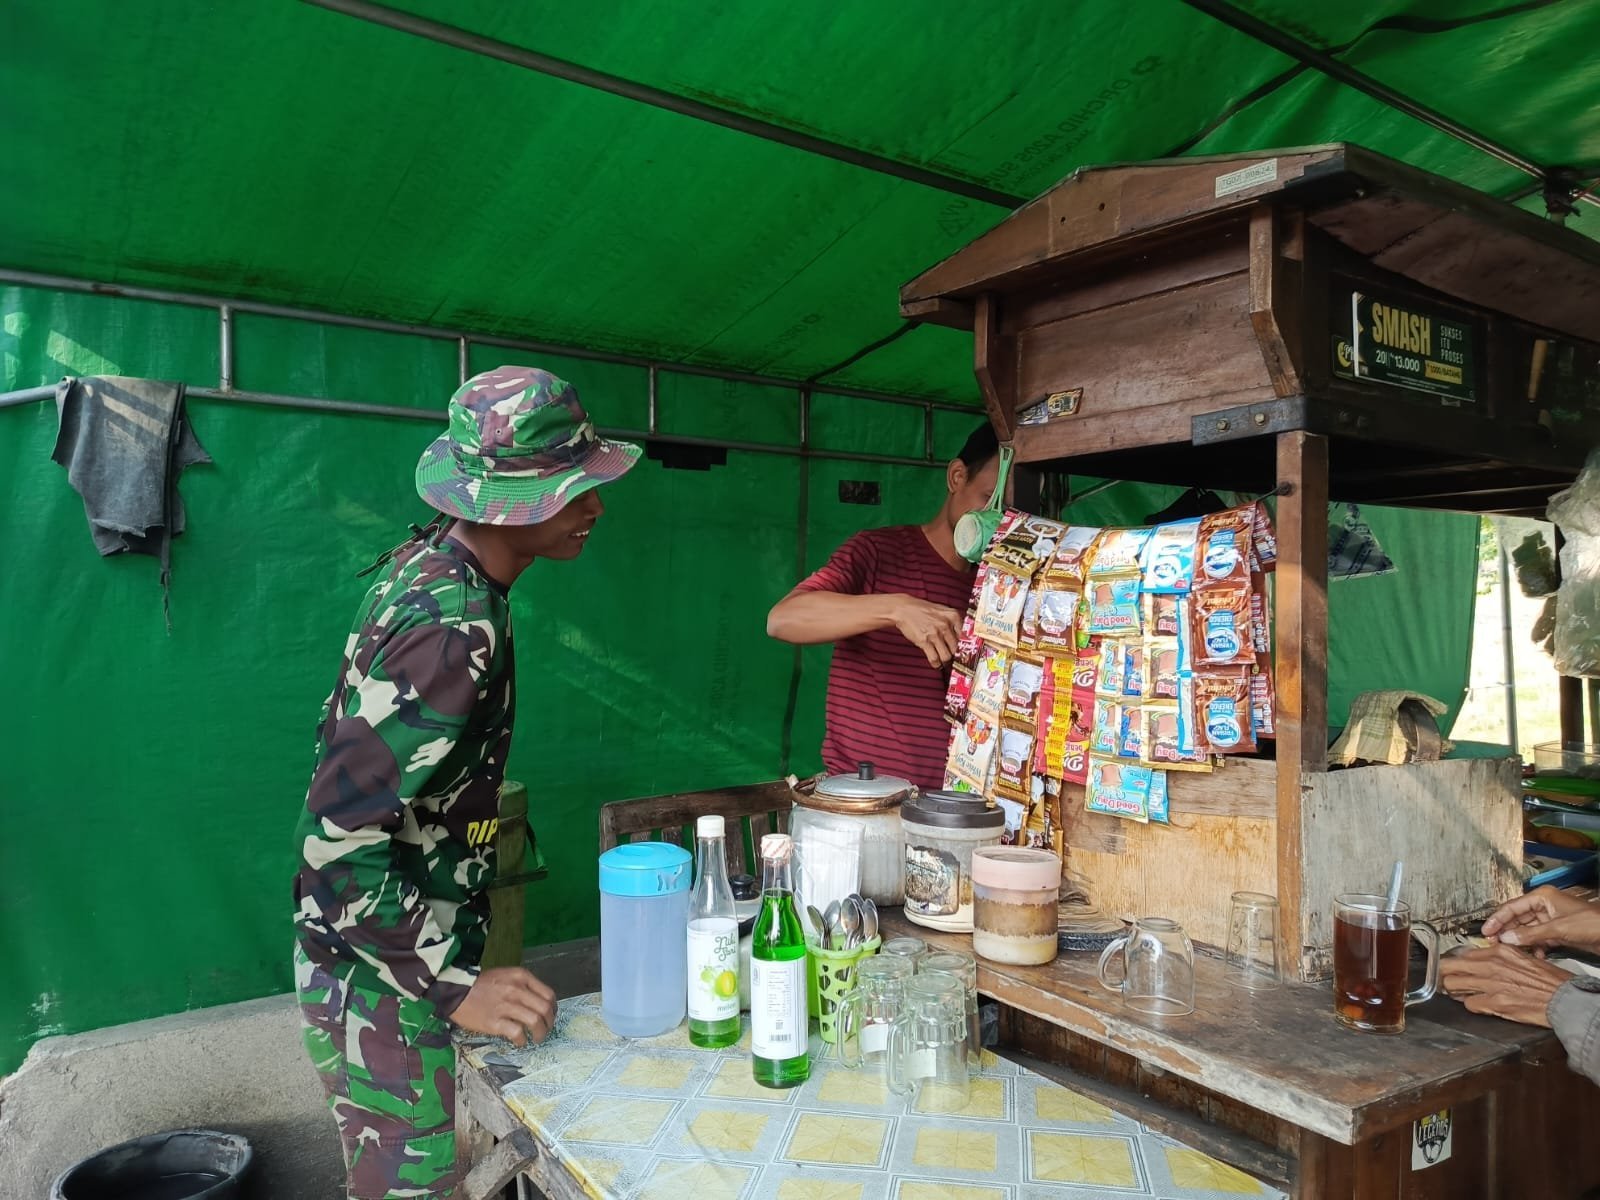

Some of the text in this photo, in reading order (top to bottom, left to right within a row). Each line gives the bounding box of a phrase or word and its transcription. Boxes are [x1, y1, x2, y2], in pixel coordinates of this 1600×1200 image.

[1372, 302, 1432, 356] SMASH
[1440, 325, 1463, 341] SUKSES
[1394, 355, 1420, 374] 13.000
[1440, 349, 1464, 365] PROSES
[994, 544, 1035, 569] ABC
[1094, 616, 1132, 627] Good Day
[1157, 621, 1177, 634] Day
[1157, 682, 1177, 696] Day
[1209, 703, 1234, 711] ENERGO
[1211, 729, 1234, 737] FRISIAN
[1155, 745, 1176, 760] Day
[1095, 795, 1140, 813] Good Day
